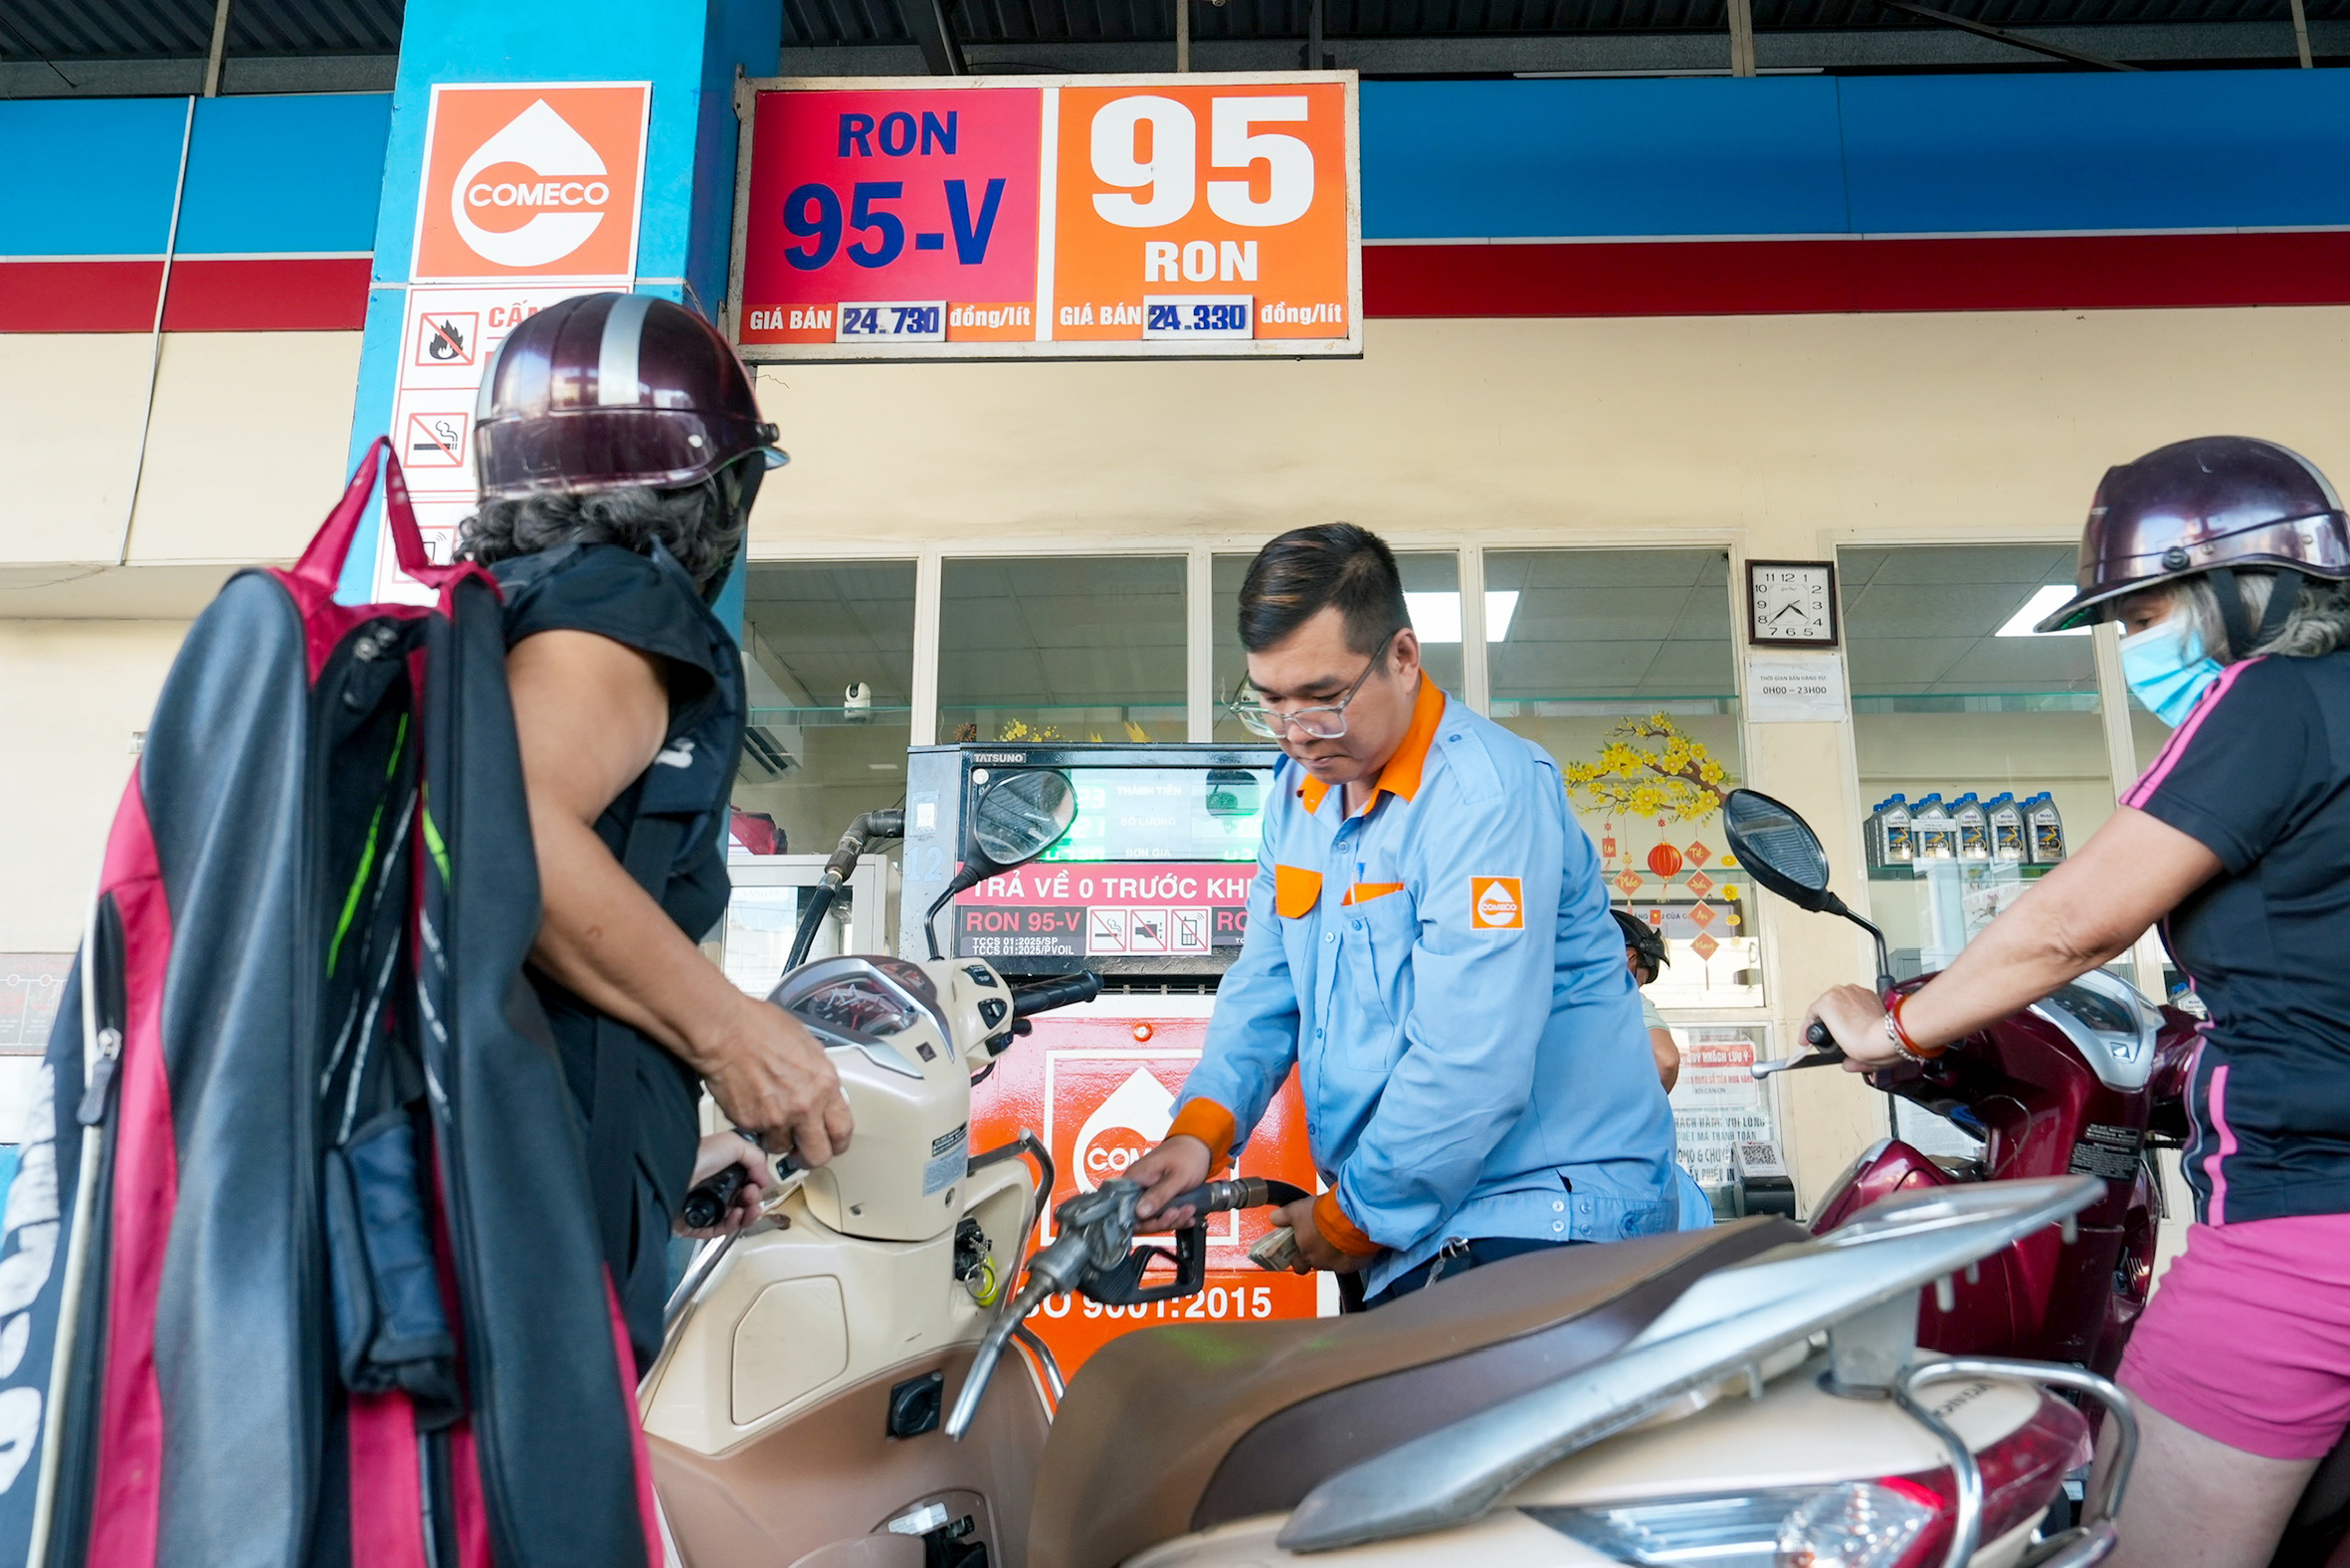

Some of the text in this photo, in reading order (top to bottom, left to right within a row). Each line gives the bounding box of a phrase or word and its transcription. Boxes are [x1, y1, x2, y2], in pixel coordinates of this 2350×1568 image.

[838, 110, 958, 157] RON
[1089, 95, 1315, 228] 95
[468, 181, 610, 207] COMECO
[782, 178, 1006, 271] 95-V
[1144, 240, 1258, 282] RON
[488, 299, 550, 327] CẤ
[750, 304, 1031, 334] GIÁ BÁN 24.730 đồng/lít
[1060, 301, 1342, 329] GIÁ BÁN 24.330 đồng/lít
[1766, 573, 1775, 582] 11
[1781, 573, 1795, 582] 12
[1755, 584, 1767, 593] 10
[1812, 585, 1822, 594] 2
[1757, 600, 1767, 609] 9
[1812, 601, 1823, 610] 3
[1757, 615, 1768, 624] 8
[1813, 618, 1823, 627] 4
[1769, 627, 1778, 636] 7
[1804, 628, 1813, 637] 5
[974, 753, 1024, 763] TATSUNO
[905, 846, 943, 882] 12
[974, 870, 1026, 897] TRẢ
[1034, 870, 1070, 898] VỀ
[1078, 878, 1093, 898] 0
[1101, 873, 1197, 898] TRƯỚC
[1481, 902, 1518, 912] COMECO
[966, 911, 1081, 932] RON 95-V
[1217, 911, 1249, 931] RO
[1003, 937, 1058, 946] 01:2025/SP
[973, 945, 1075, 955] TCCS 01:2025/PVOIL
[1674, 1115, 1696, 1127] HÁCH
[1725, 1116, 1740, 1127] VUI
[1086, 1147, 1152, 1171] COM
[1677, 1148, 1695, 1162] OMO
[1697, 1148, 1703, 1162] &
[1727, 1168, 1735, 1181] IN
[1932, 1381, 1988, 1418] ONDA
